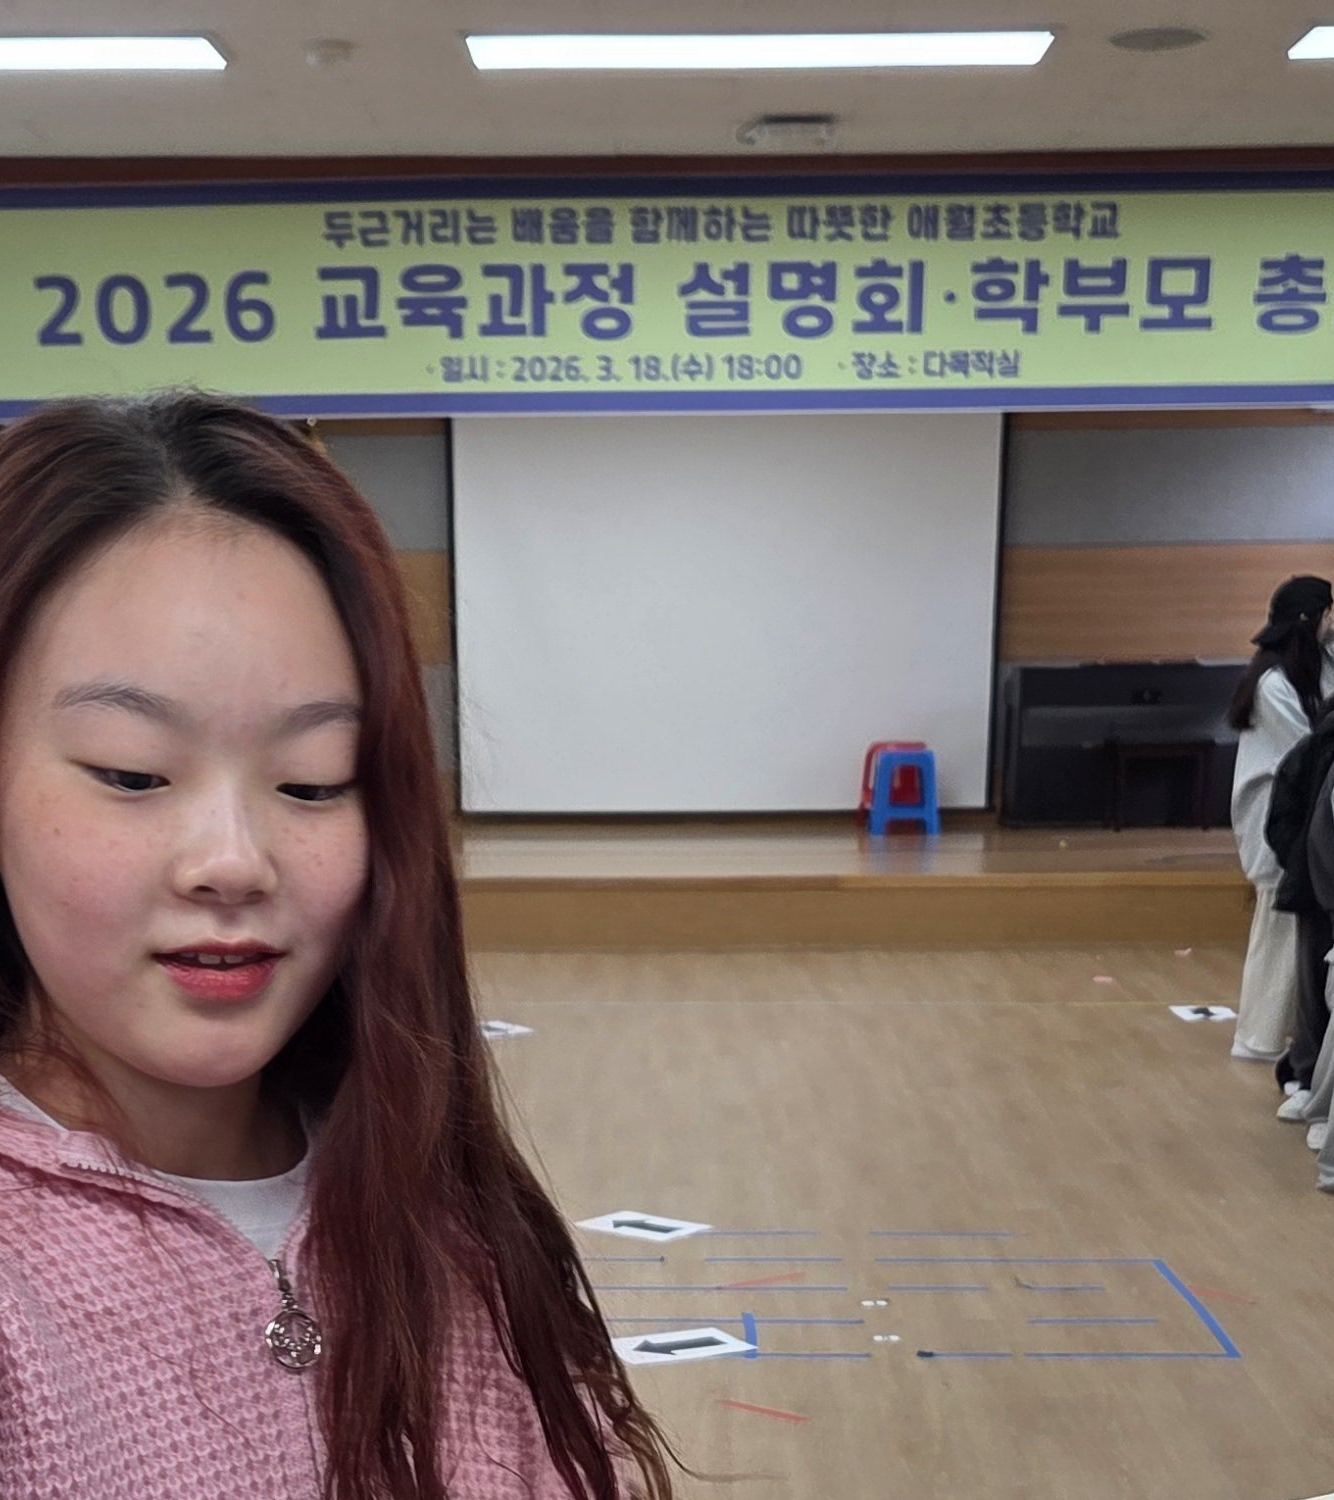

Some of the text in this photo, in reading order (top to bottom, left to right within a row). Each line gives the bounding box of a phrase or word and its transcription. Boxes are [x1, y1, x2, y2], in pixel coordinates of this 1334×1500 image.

[323, 207, 497, 249] 두근거리는
[511, 205, 613, 245] 배움을
[630, 203, 772, 244] 함께하는
[785, 203, 893, 243] 따뜻한
[33, 271, 276, 347] 2026
[315, 261, 635, 341] 교육과정
[723, 352, 803, 381] 18:00
